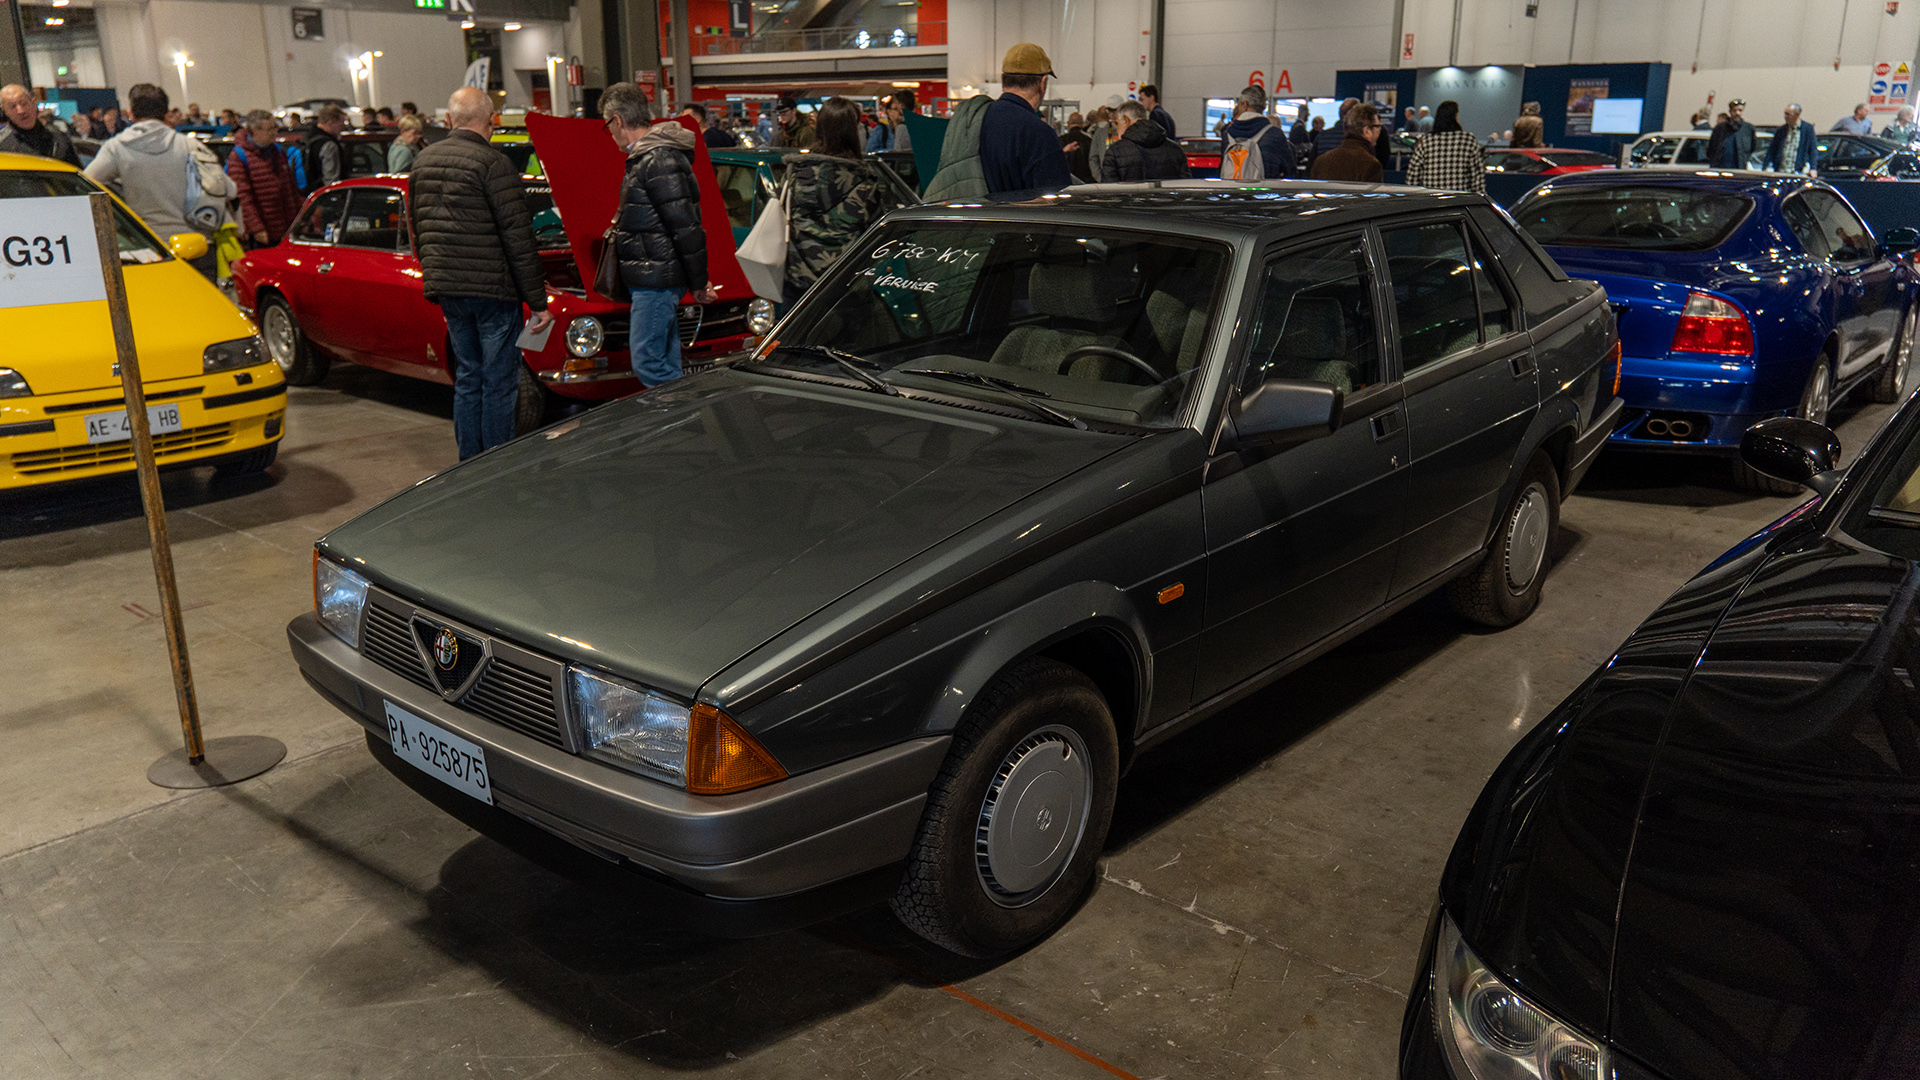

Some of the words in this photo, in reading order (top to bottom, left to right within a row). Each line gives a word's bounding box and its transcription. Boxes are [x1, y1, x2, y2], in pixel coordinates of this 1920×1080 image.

[733, 3, 748, 29] L
[1275, 70, 1293, 94] A
[3, 235, 71, 267] G31
[158, 409, 179, 427] HB
